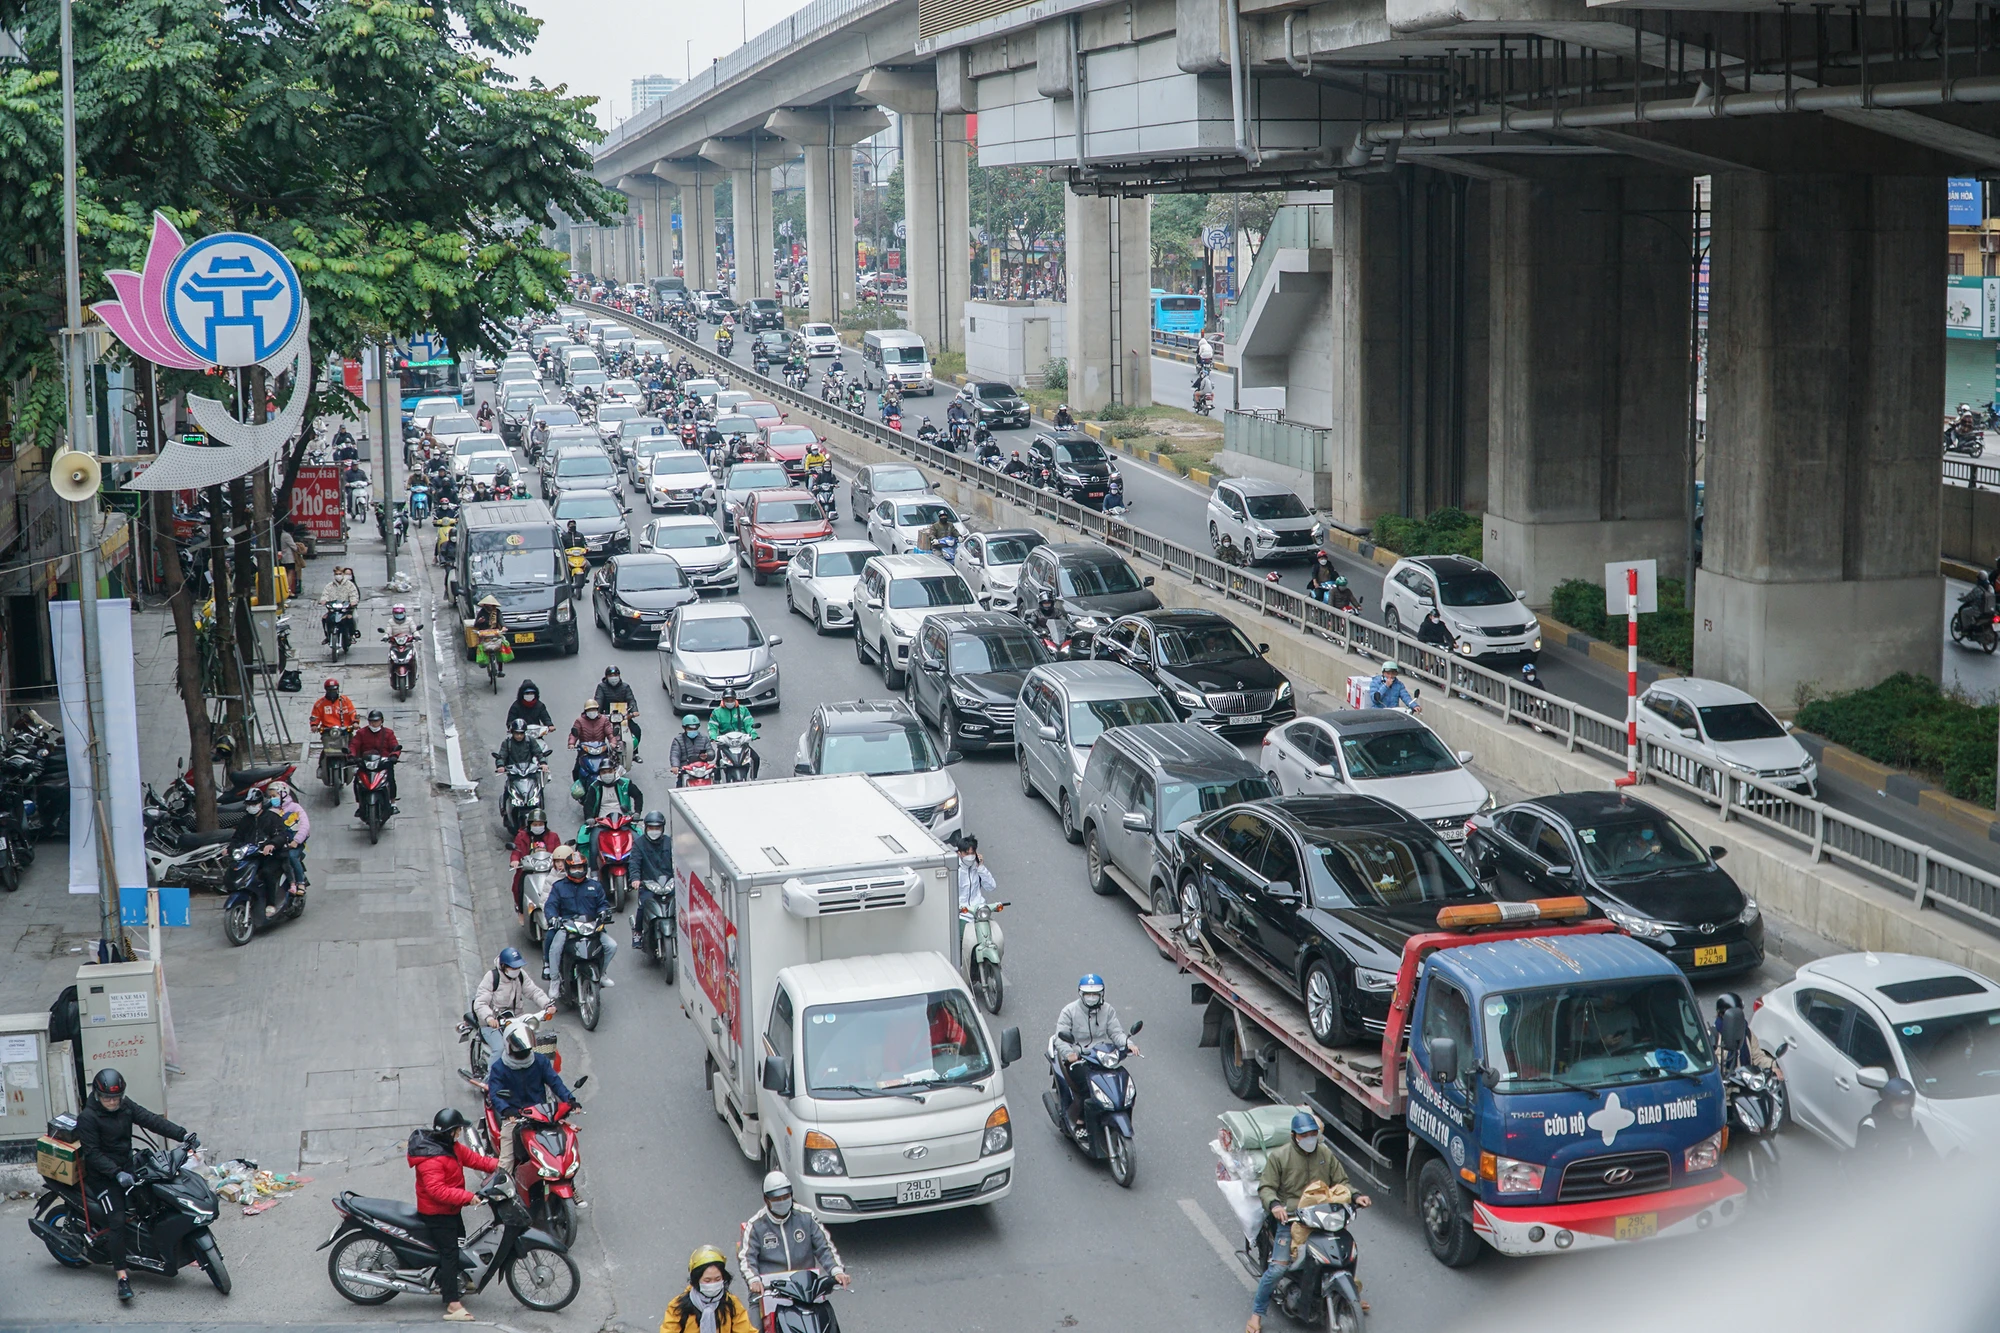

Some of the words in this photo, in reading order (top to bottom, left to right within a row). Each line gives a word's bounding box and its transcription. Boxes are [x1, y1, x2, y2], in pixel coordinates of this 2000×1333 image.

[319, 470, 336, 479] Hải
[291, 483, 323, 516] Phở
[324, 489, 339, 499] Bò
[325, 504, 339, 515] Gà
[1491, 529, 1498, 541] F2
[1704, 618, 1713, 632] F3
[1704, 947, 1718, 956] 30A
[1699, 955, 1723, 965] 724.38
[1544, 1113, 1567, 1136] CỨU
[1570, 1112, 1586, 1137] HỘ
[1637, 1105, 1662, 1125] GIAO
[1665, 1098, 1698, 1121] THÔNG
[906, 1180, 932, 1191] 29LD
[902, 1189, 937, 1202] 318.45
[1628, 1215, 1646, 1227] 29C
